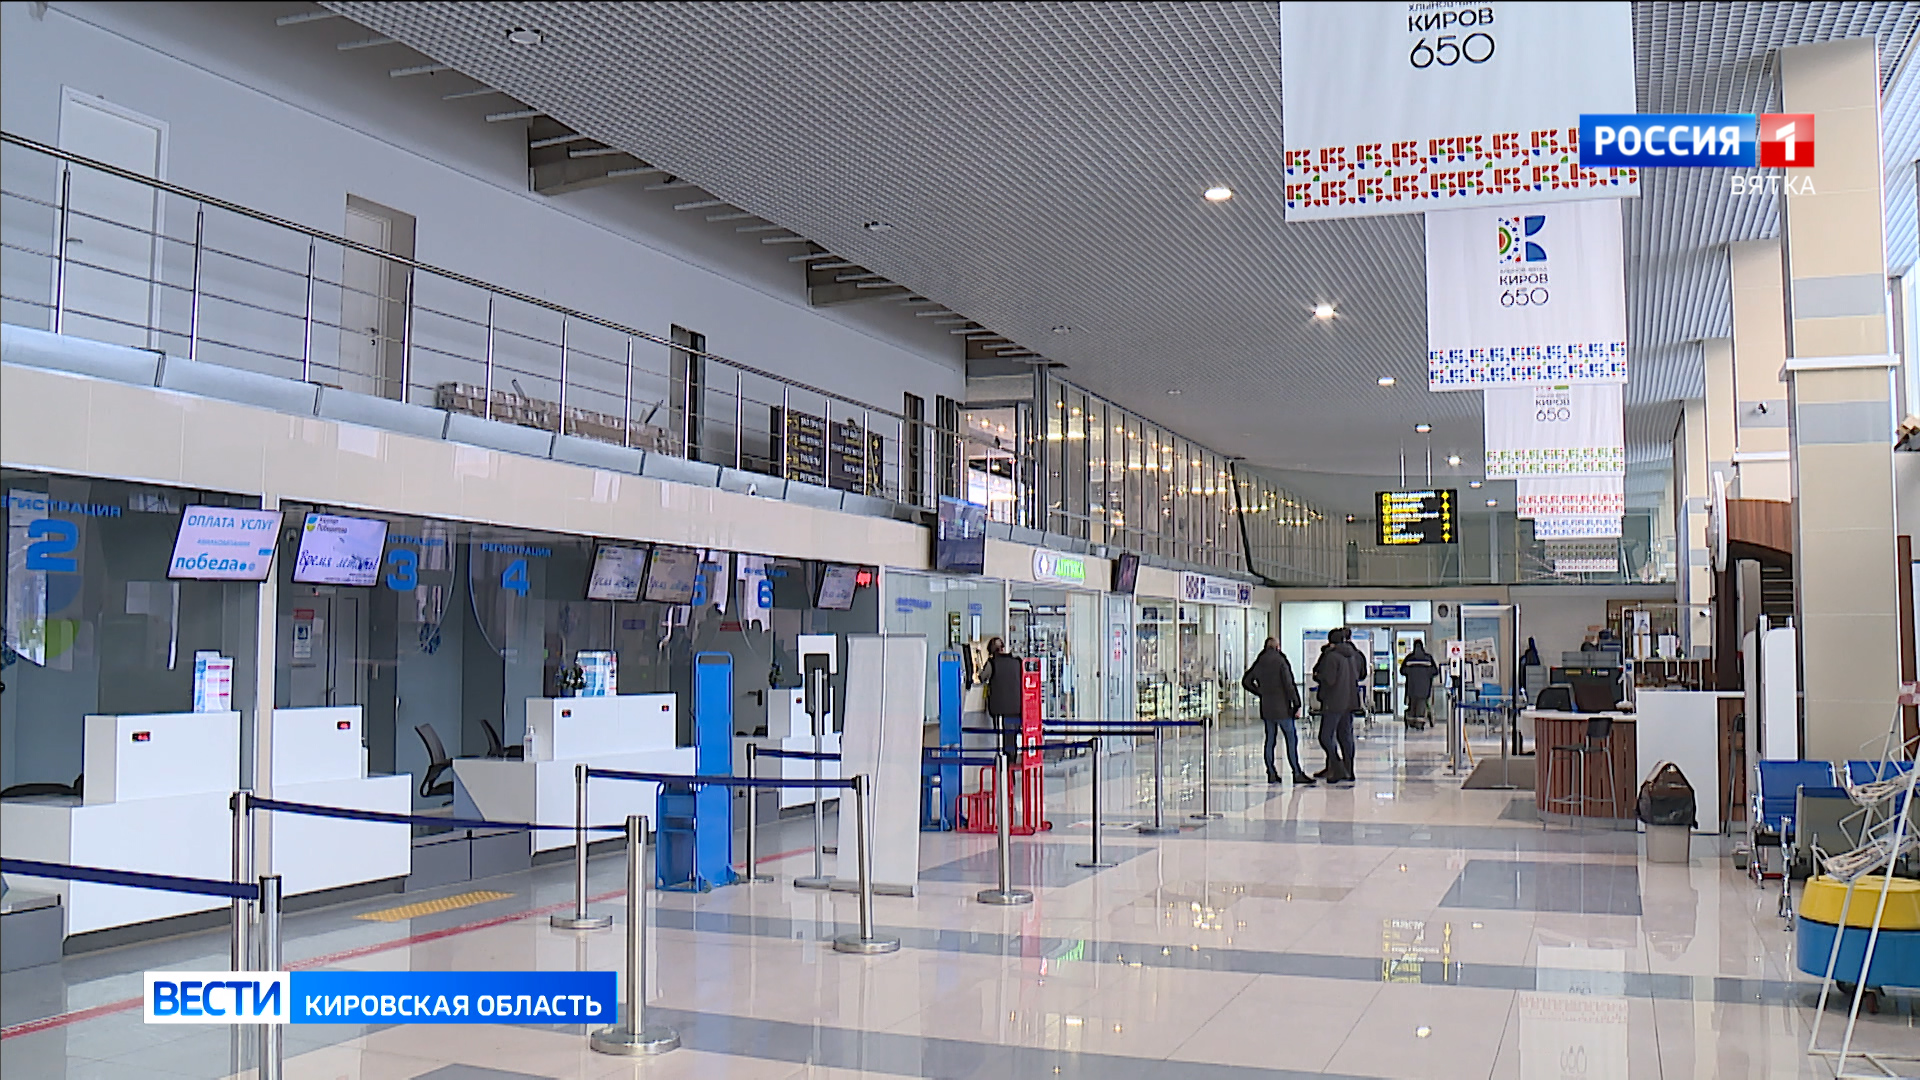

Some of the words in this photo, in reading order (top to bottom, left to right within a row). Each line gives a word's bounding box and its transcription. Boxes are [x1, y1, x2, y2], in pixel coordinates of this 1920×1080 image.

[1408, 7, 1494, 32] КИРОВ
[1410, 32, 1495, 68] 650
[1499, 273, 1548, 286] КИРОВ
[1500, 287, 1549, 308] 650
[1536, 407, 1571, 422] 650
[188, 515, 234, 528] ОПЛАТА
[240, 519, 275, 530] УСЛУГ
[25, 518, 79, 573] 2
[481, 543, 552, 558] РЕГИСТРАЦИЯ
[175, 552, 239, 571] победа
[386, 549, 418, 592] 3
[501, 559, 531, 597] 4
[758, 579, 774, 608] 6
